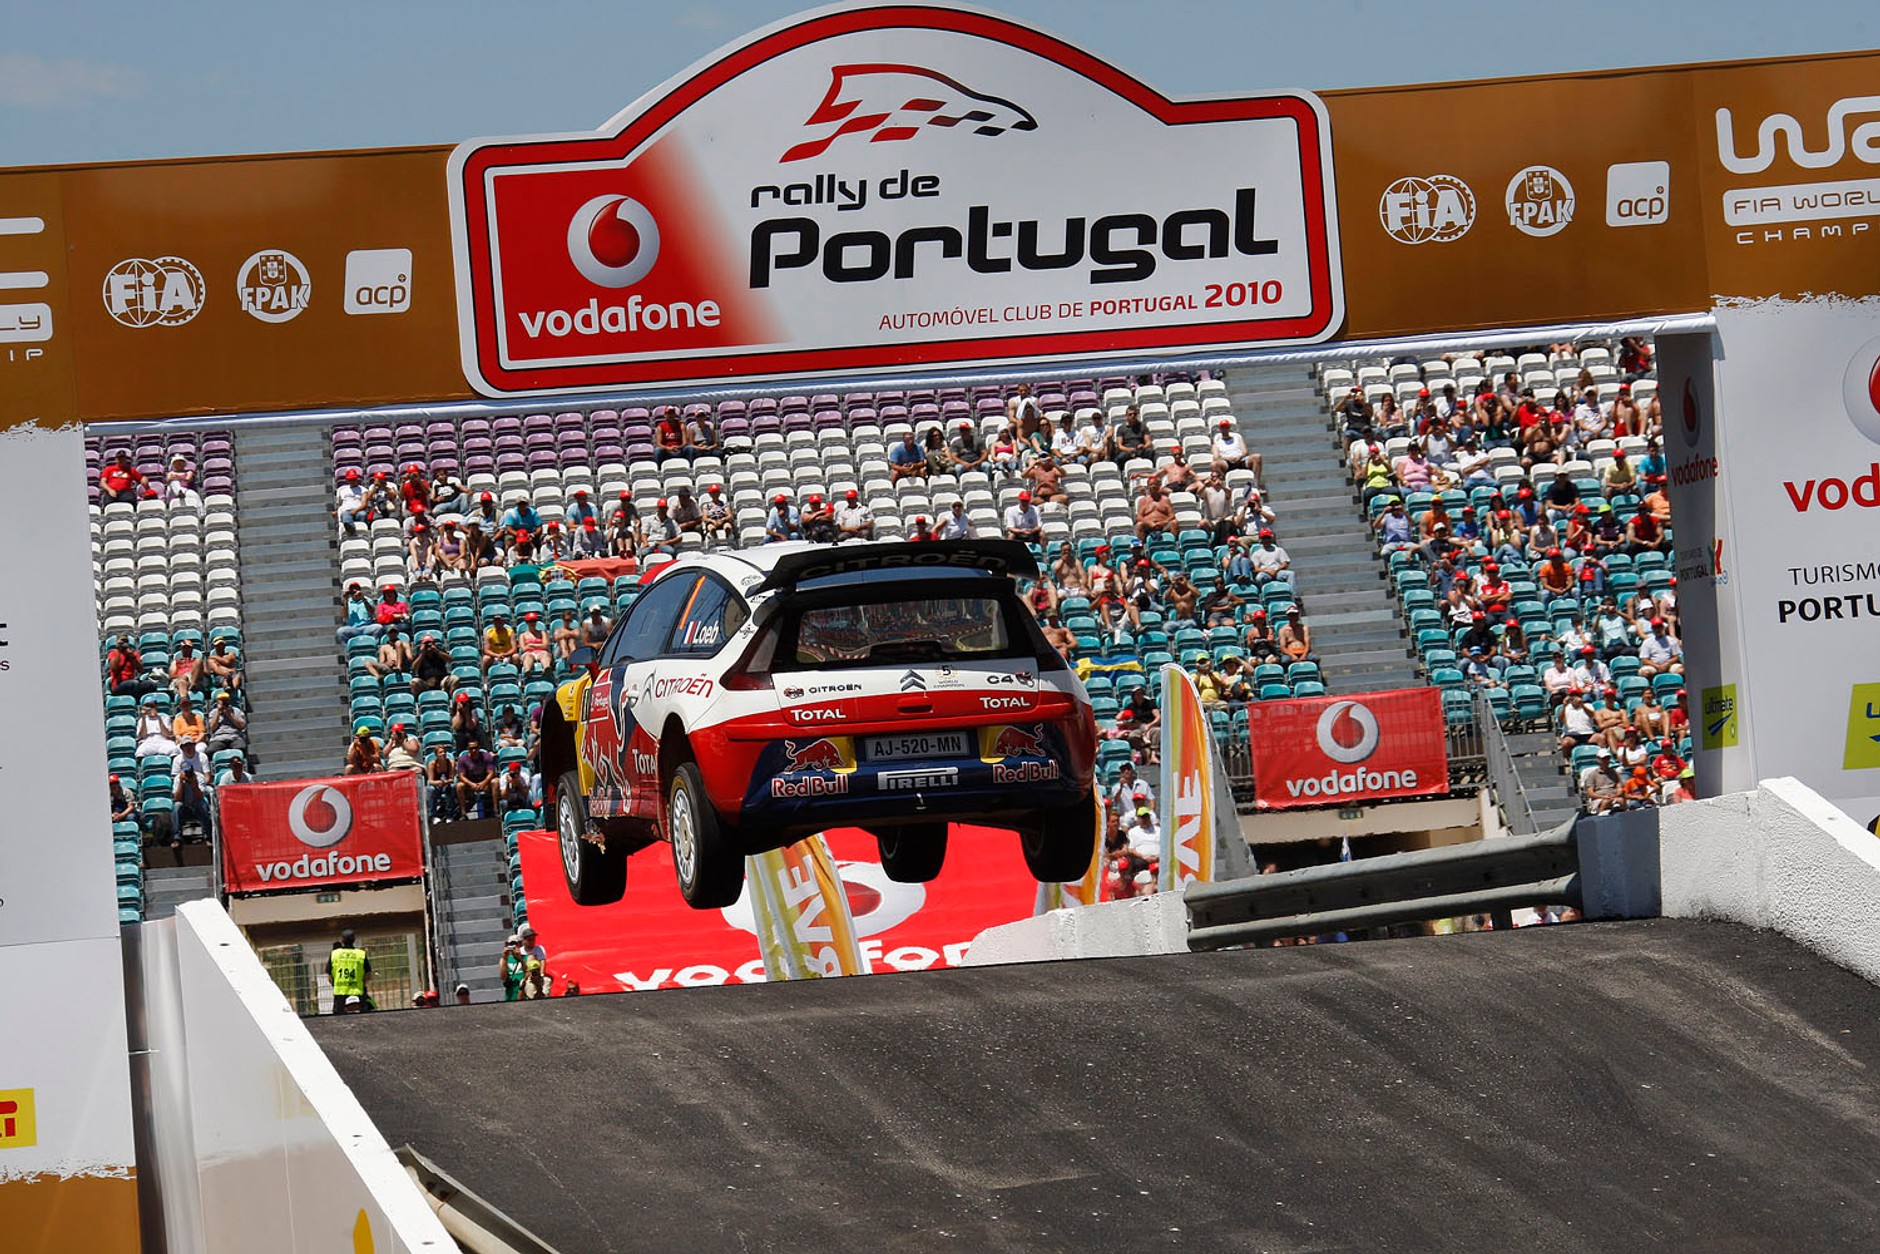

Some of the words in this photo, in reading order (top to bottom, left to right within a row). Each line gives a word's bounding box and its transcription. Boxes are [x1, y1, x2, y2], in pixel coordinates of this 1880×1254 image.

[751, 174, 867, 211] rally
[879, 169, 941, 200] de
[1509, 198, 1574, 226] FPAK
[1617, 196, 1665, 220] acp
[1735, 198, 1781, 214] FIA
[750, 188, 1279, 288] Portugal
[241, 284, 309, 311] FPAK
[356, 284, 407, 308] acp
[879, 307, 999, 330] AUTOMÓVEL
[1004, 303, 1052, 322] CLUB
[1058, 301, 1083, 318] DE
[1090, 295, 1198, 316] PORTUGAL
[1204, 280, 1283, 308] 2010
[518, 295, 721, 338] vodafone
[1671, 453, 1718, 487] vodafone
[692, 620, 719, 644] Loeb
[808, 683, 862, 694] CITROËN
[986, 674, 1014, 684] C4
[790, 707, 847, 721] TOTAL
[979, 697, 1031, 709] TOTAL
[874, 736, 962, 757] AJ-520-MN
[877, 767, 959, 790] PIRELLI
[993, 763, 1026, 784] Red
[1029, 759, 1059, 781] Bull
[1286, 767, 1418, 798] vodafone
[771, 777, 809, 798] Red
[812, 773, 849, 795] Bull
[256, 850, 392, 882] vodafone
[338, 968, 356, 979] 194
